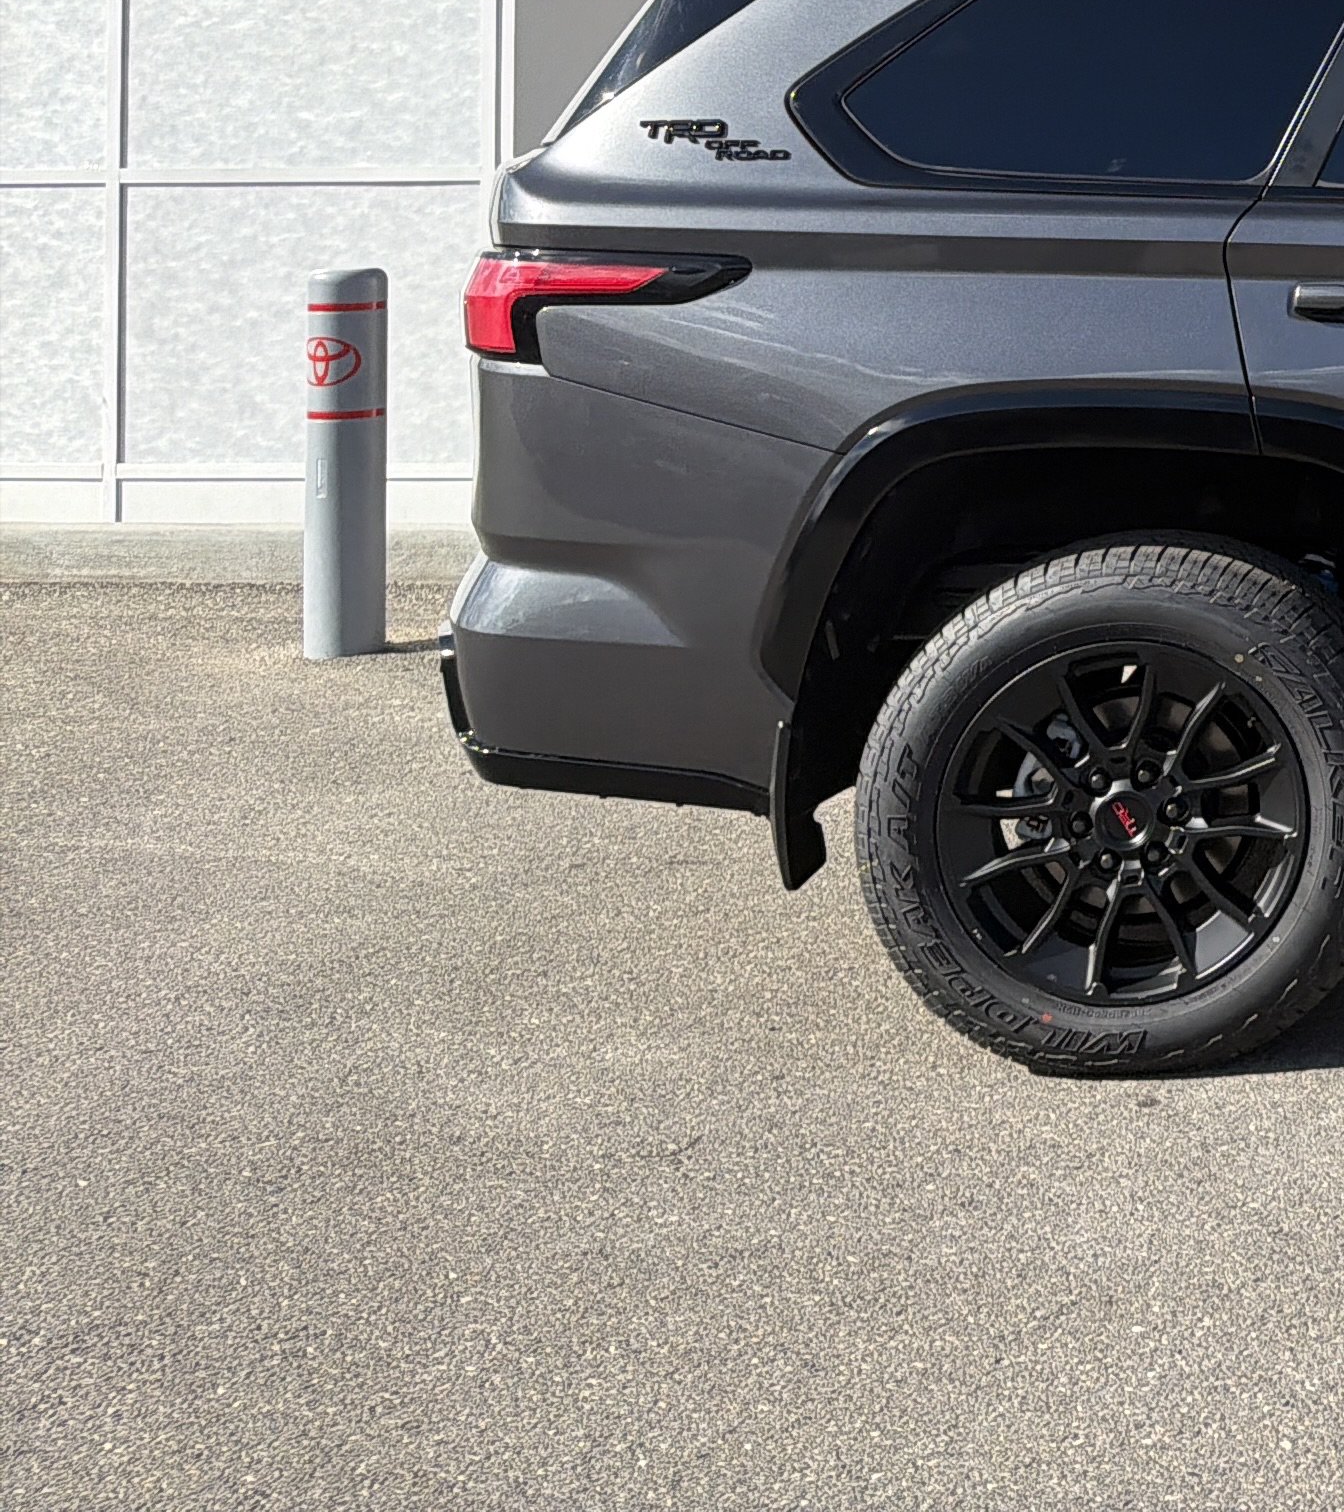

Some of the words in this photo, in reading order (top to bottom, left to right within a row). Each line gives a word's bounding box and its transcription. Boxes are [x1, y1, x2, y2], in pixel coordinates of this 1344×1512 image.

[640, 119, 728, 144] TRD
[704, 140, 761, 151] OFF
[715, 149, 792, 161] ROAD
[1111, 801, 1138, 838] TRD
[886, 861, 1149, 1055] WILDPEAK
